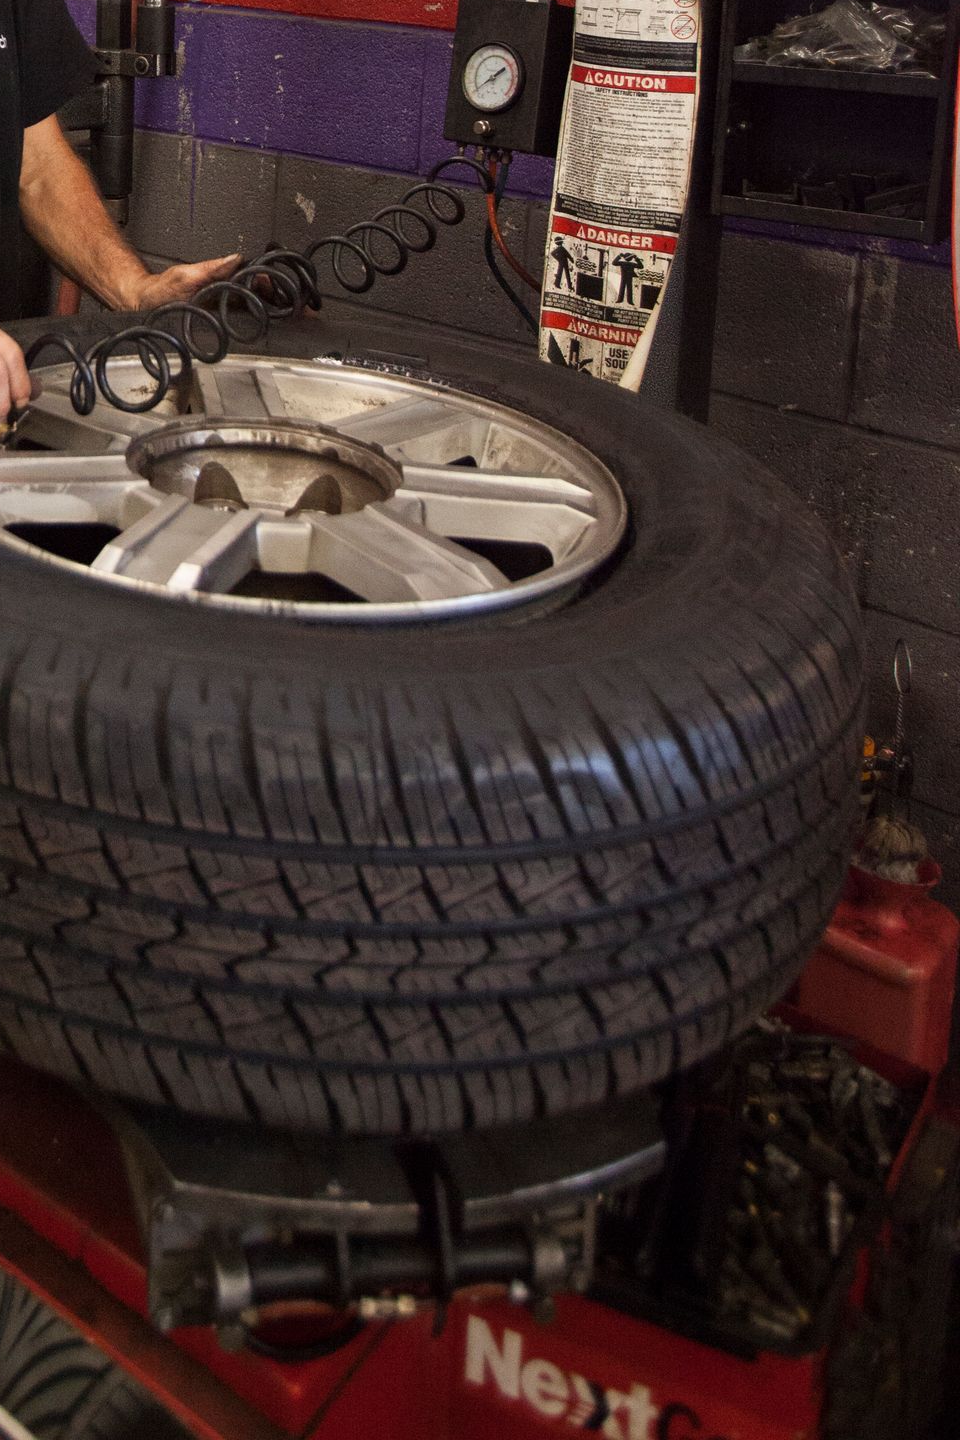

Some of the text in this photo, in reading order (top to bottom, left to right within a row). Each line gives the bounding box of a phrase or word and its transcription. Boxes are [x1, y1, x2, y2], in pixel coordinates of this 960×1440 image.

[594, 72, 666, 90] CAUTION
[612, 88, 649, 98] INSTRUCTIONS
[587, 228, 653, 248] DANGER
[576, 321, 640, 344] WARNIN
[609, 347, 629, 359] USE
